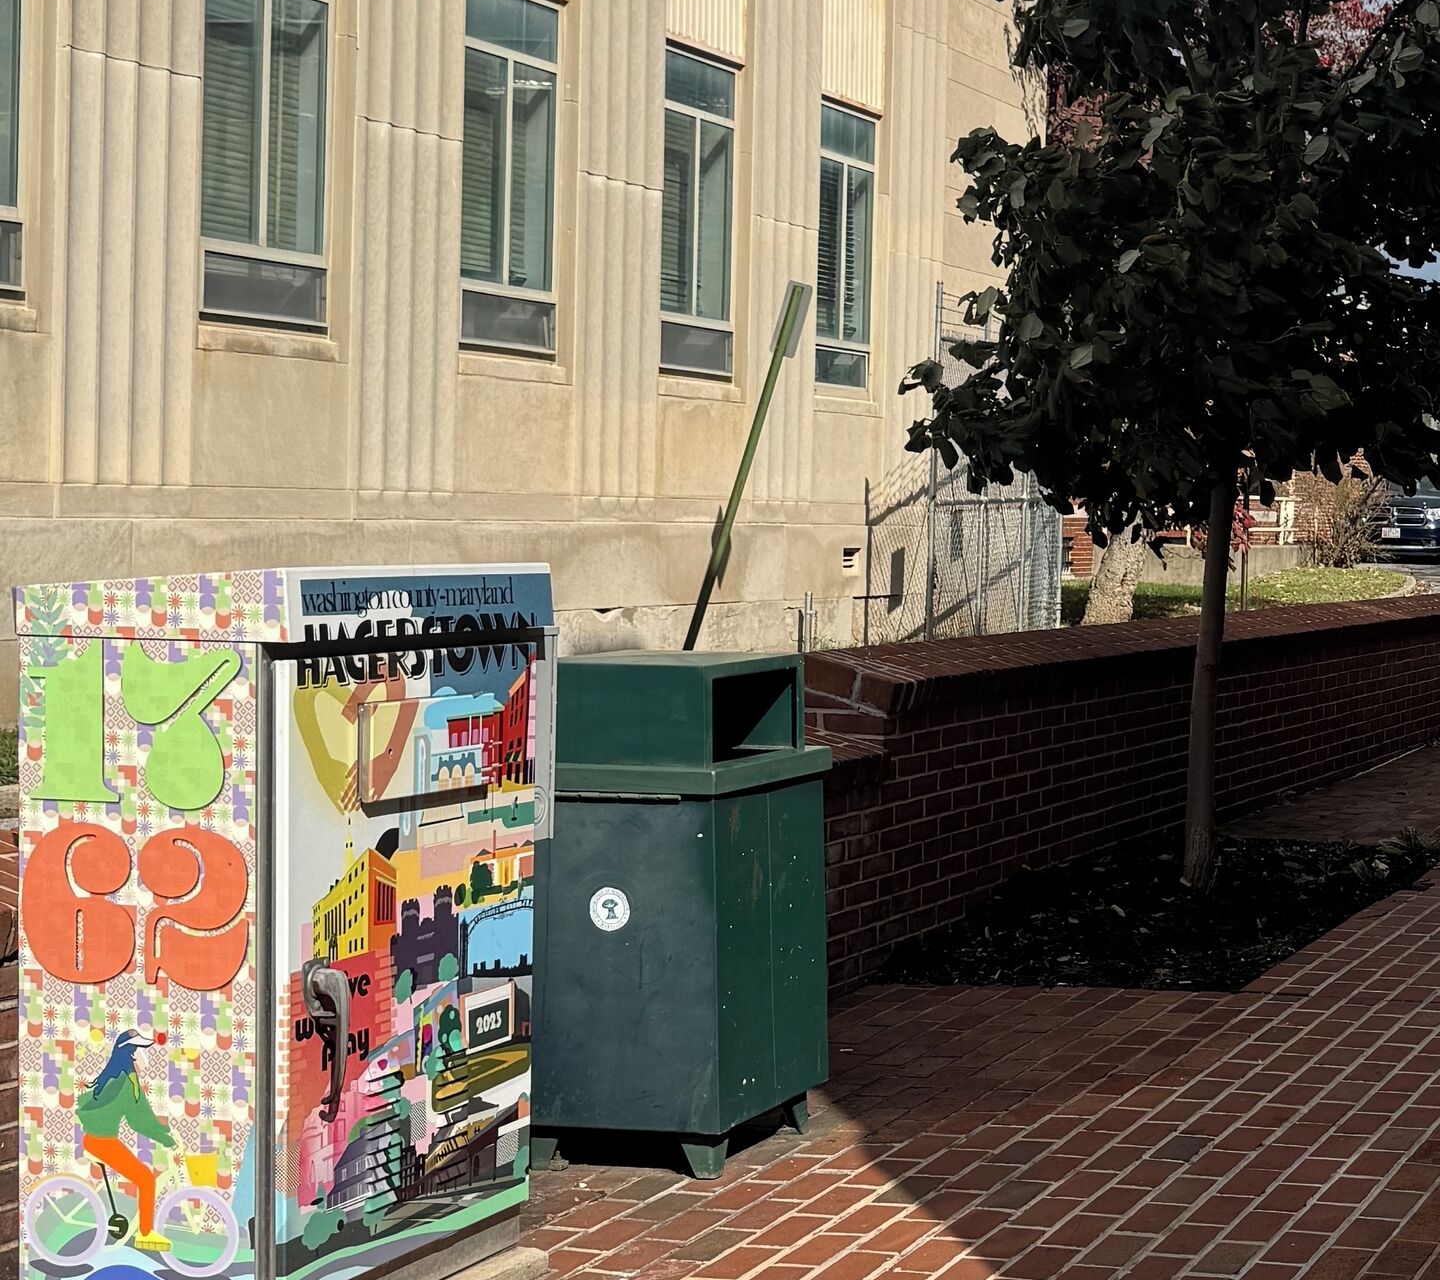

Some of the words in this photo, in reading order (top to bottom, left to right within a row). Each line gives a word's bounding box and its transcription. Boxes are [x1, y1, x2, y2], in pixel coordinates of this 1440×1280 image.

[302, 582, 392, 618] washington
[297, 610, 538, 689] HAGERSTOWN
[27, 639, 242, 810] 17
[22, 823, 249, 991] 62
[475, 1010, 502, 1035] 2023
